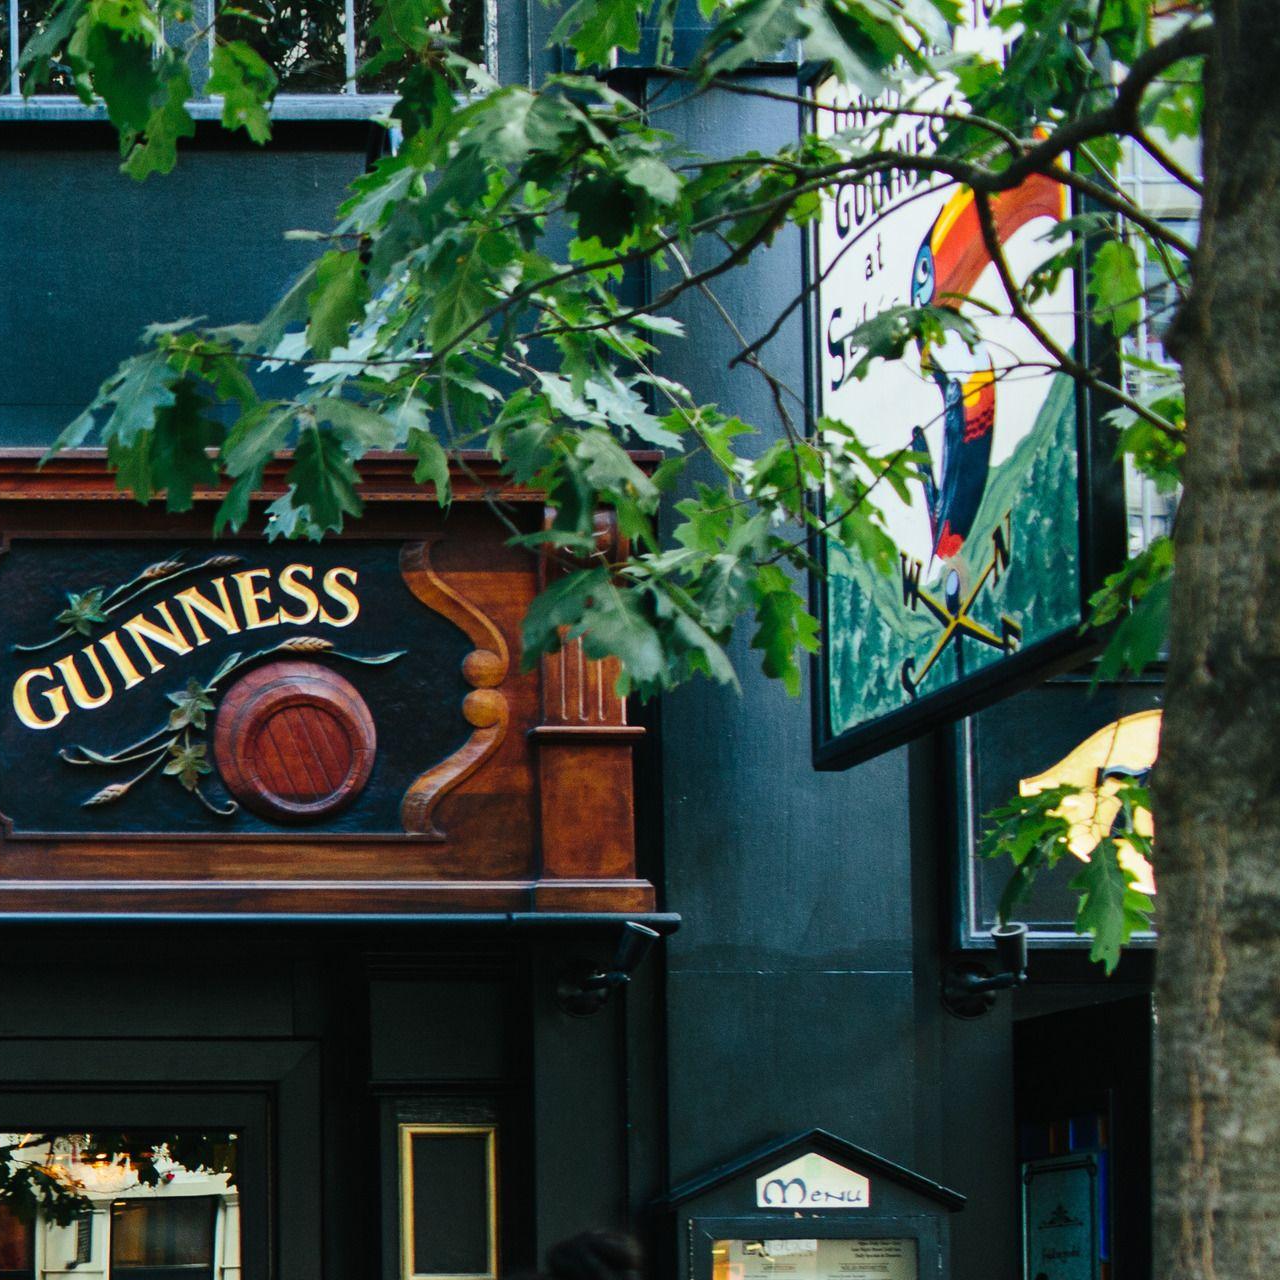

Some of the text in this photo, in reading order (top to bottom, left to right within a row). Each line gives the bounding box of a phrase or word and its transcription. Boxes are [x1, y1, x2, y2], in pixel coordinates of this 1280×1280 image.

[865, 233, 883, 280] at
[992, 509, 1012, 591] N
[899, 551, 922, 612] W
[12, 563, 361, 731] GUINNESS
[762, 1177, 862, 1205] Menu
